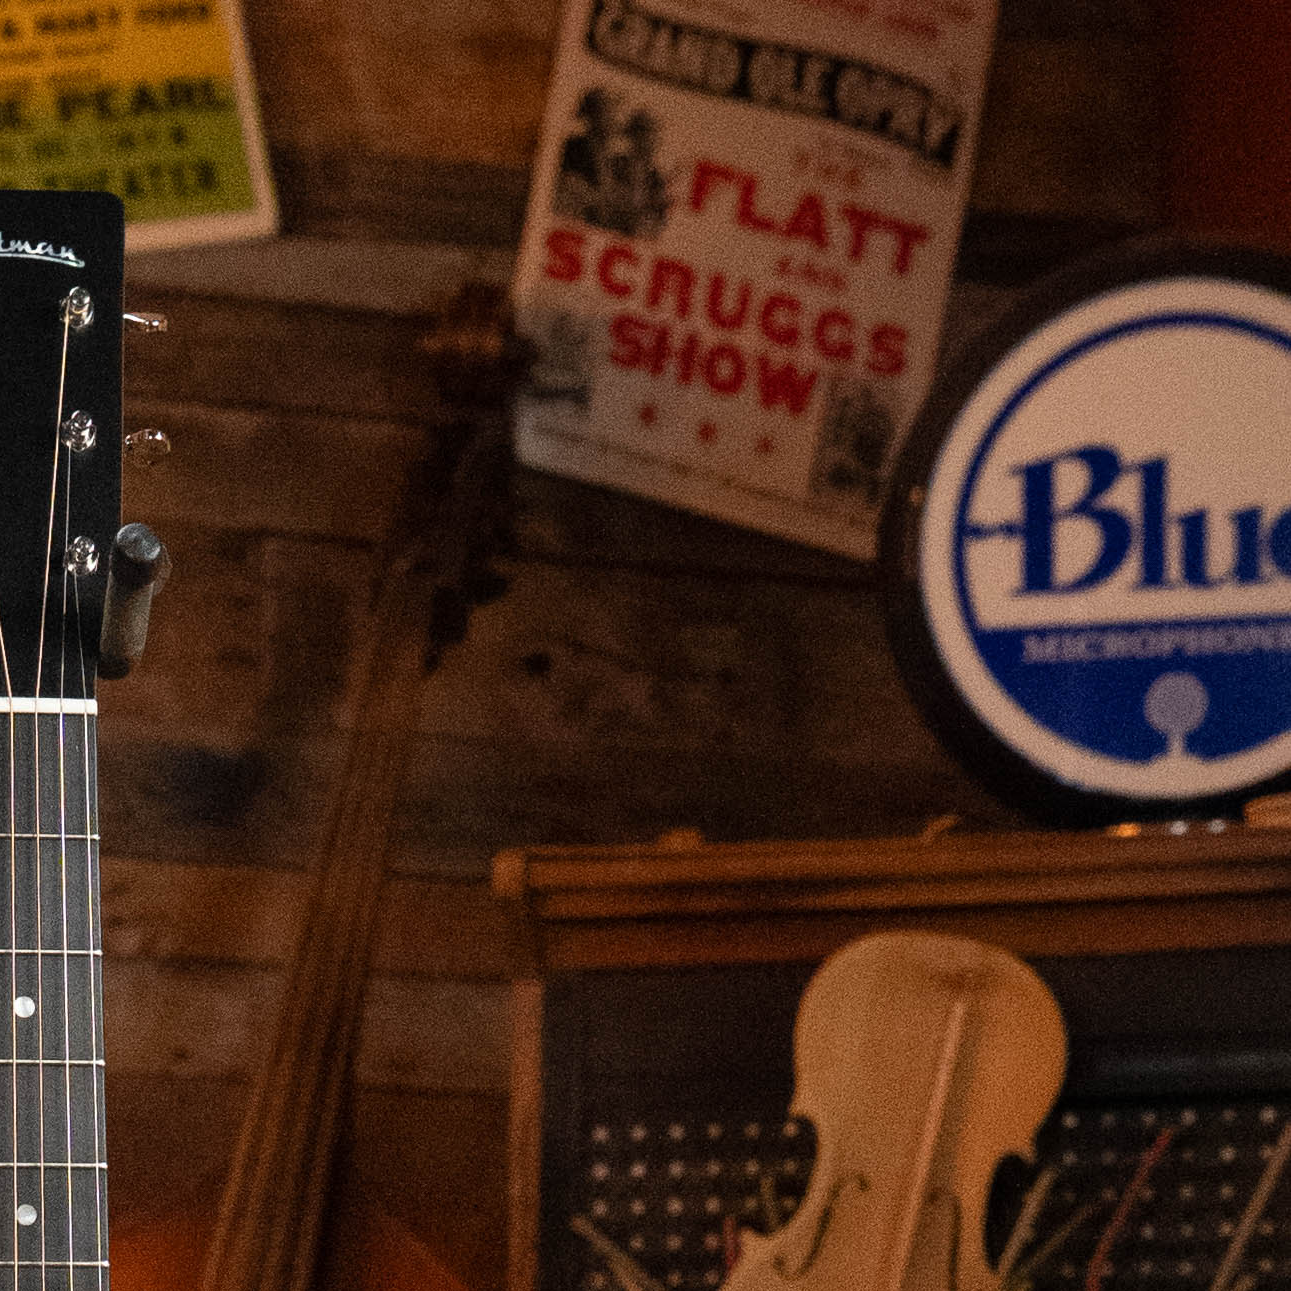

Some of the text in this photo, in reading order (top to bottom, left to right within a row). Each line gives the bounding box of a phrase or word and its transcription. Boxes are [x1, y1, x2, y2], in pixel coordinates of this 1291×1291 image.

[688, 159, 930, 276] FLATT
[544, 228, 908, 377] SCRUGGS
[609, 313, 818, 419] SHOW
